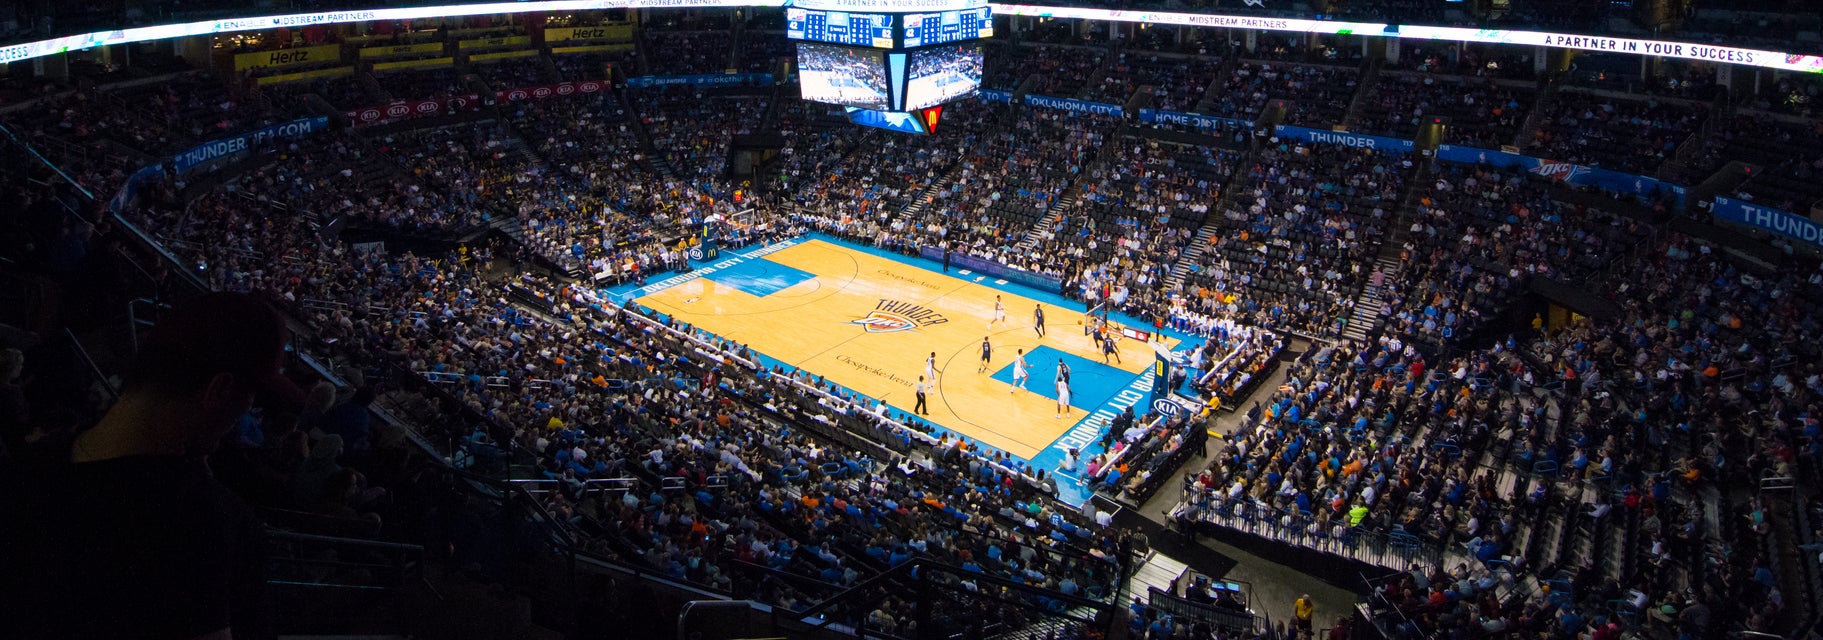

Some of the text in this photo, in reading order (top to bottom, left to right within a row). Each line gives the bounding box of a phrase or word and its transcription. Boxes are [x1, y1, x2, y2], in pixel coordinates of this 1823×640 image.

[273, 15, 325, 26] MIDSTREAM
[328, 12, 375, 23] PARTNERS
[1189, 17, 1237, 26] MIDSTREAM
[1242, 18, 1288, 28] PARTNERS
[573, 28, 605, 39] Hertz
[1545, 35, 1753, 63] A PARTNER IN YOUR SUCCESS
[270, 50, 308, 66] Hertz
[986, 92, 999, 101] TO
[1031, 97, 1087, 113] OKLAHOMA
[1091, 105, 1114, 117] CITY
[1156, 113, 1188, 126] HOME
[1309, 131, 1375, 149] THUNDER
[1540, 163, 1569, 176] OKC
[1715, 196, 1728, 205] 119
[714, 257, 744, 269] CITY
[875, 299, 949, 327] THUNDER
[1108, 390, 1143, 413] CITY
[1158, 401, 1177, 416] KIA
[1053, 409, 1116, 454] THUNDER
